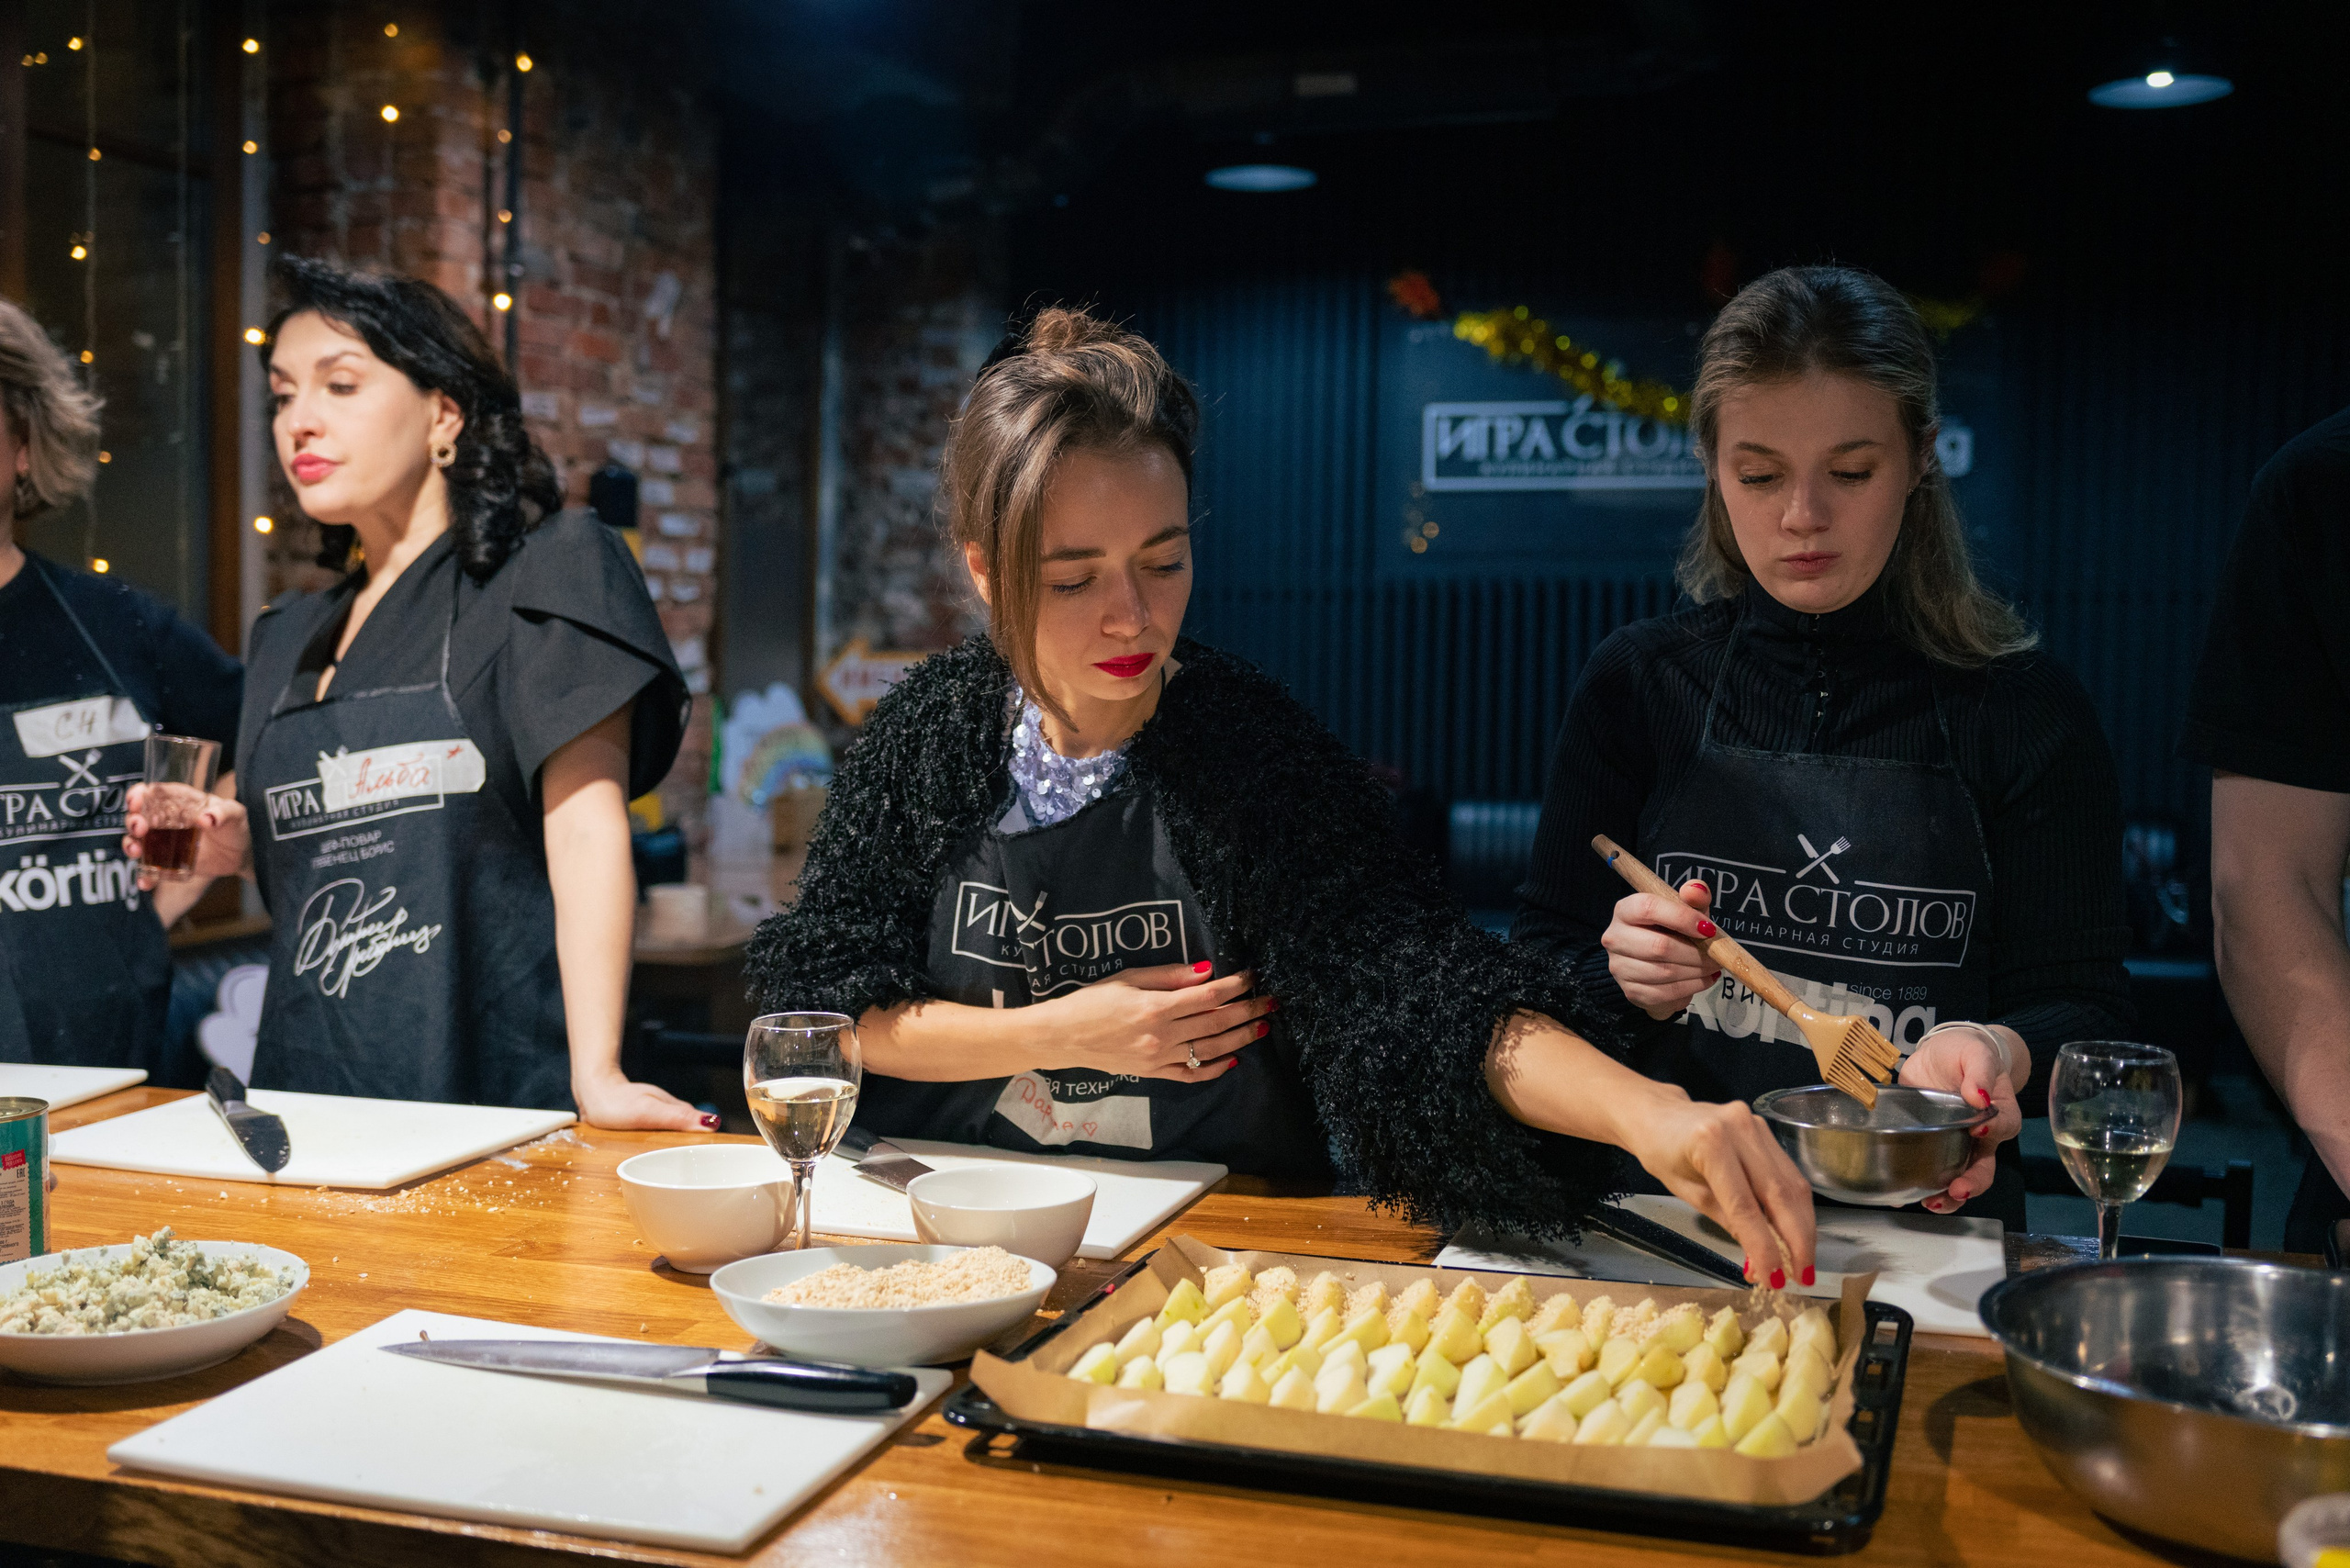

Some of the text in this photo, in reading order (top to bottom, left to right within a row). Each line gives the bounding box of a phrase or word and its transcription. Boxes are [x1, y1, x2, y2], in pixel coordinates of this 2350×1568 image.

[1784, 884, 1967, 940] СТОЛОВ
[1018, 912, 1172, 969] ТОЛОВ
[1711, 914, 1919, 957] УЛИНАРНАЯ СТУДИЯ
[1059, 958, 1124, 979] СТУДИЯ
[1849, 982, 1928, 1002] since 1889
